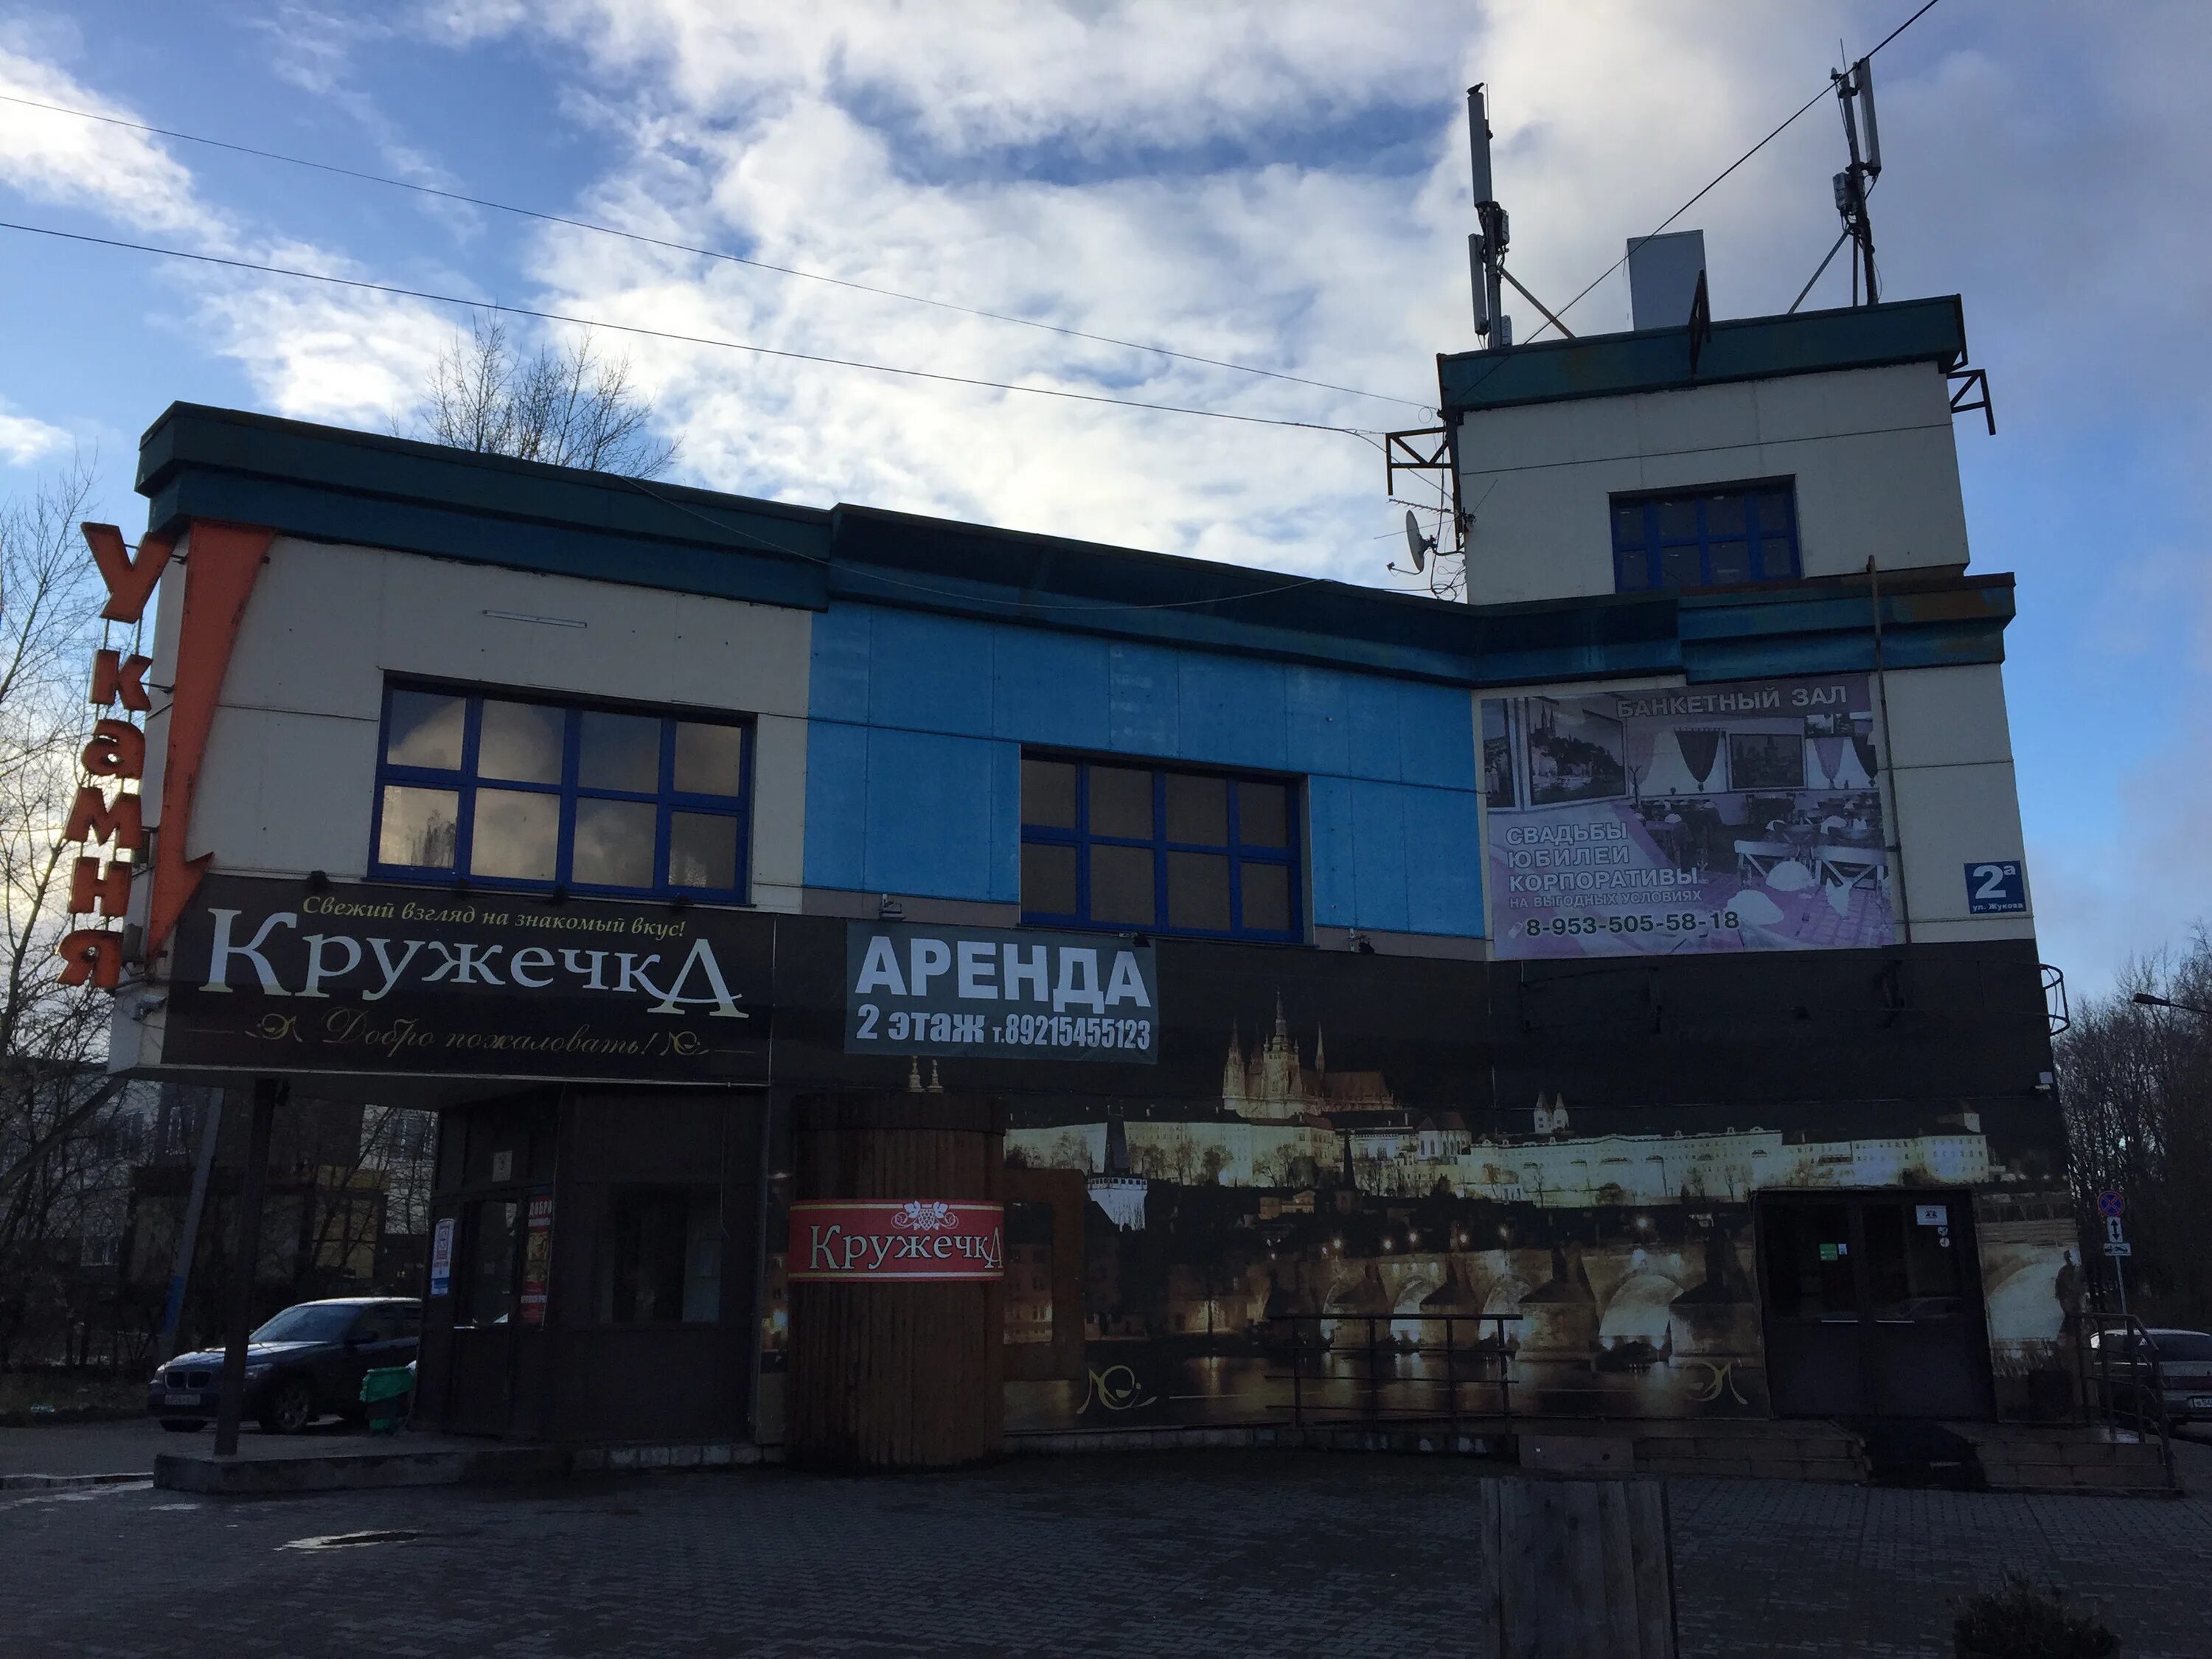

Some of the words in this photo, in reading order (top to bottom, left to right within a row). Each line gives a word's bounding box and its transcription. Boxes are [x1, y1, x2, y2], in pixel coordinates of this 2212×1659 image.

[1617, 685, 1781, 717] БАНКЕТНЫЙ
[1791, 685, 1847, 707] ЗАЛ
[1506, 822, 1628, 846] СВАДЬБЫ
[1509, 867, 1698, 892] КОРПОРАТИВЫ
[1509, 897, 1528, 909] НА
[1533, 893, 1618, 908] ВЫГОДНЫХ
[1621, 890, 1703, 905] УСЛОВИЯХ
[302, 895, 395, 919] Свежий
[401, 902, 476, 924] взгляд
[481, 911, 509, 926] на
[515, 913, 626, 934] знакомый
[631, 917, 687, 941] вкус!
[1526, 911, 1739, 936] 8-953-505-58-18
[855, 936, 1151, 1015] АРЕНДА
[321, 1006, 437, 1057] Добро
[445, 1023, 658, 1057] пожаловать!
[855, 1004, 880, 1040] 2
[888, 1012, 986, 1043] этаж
